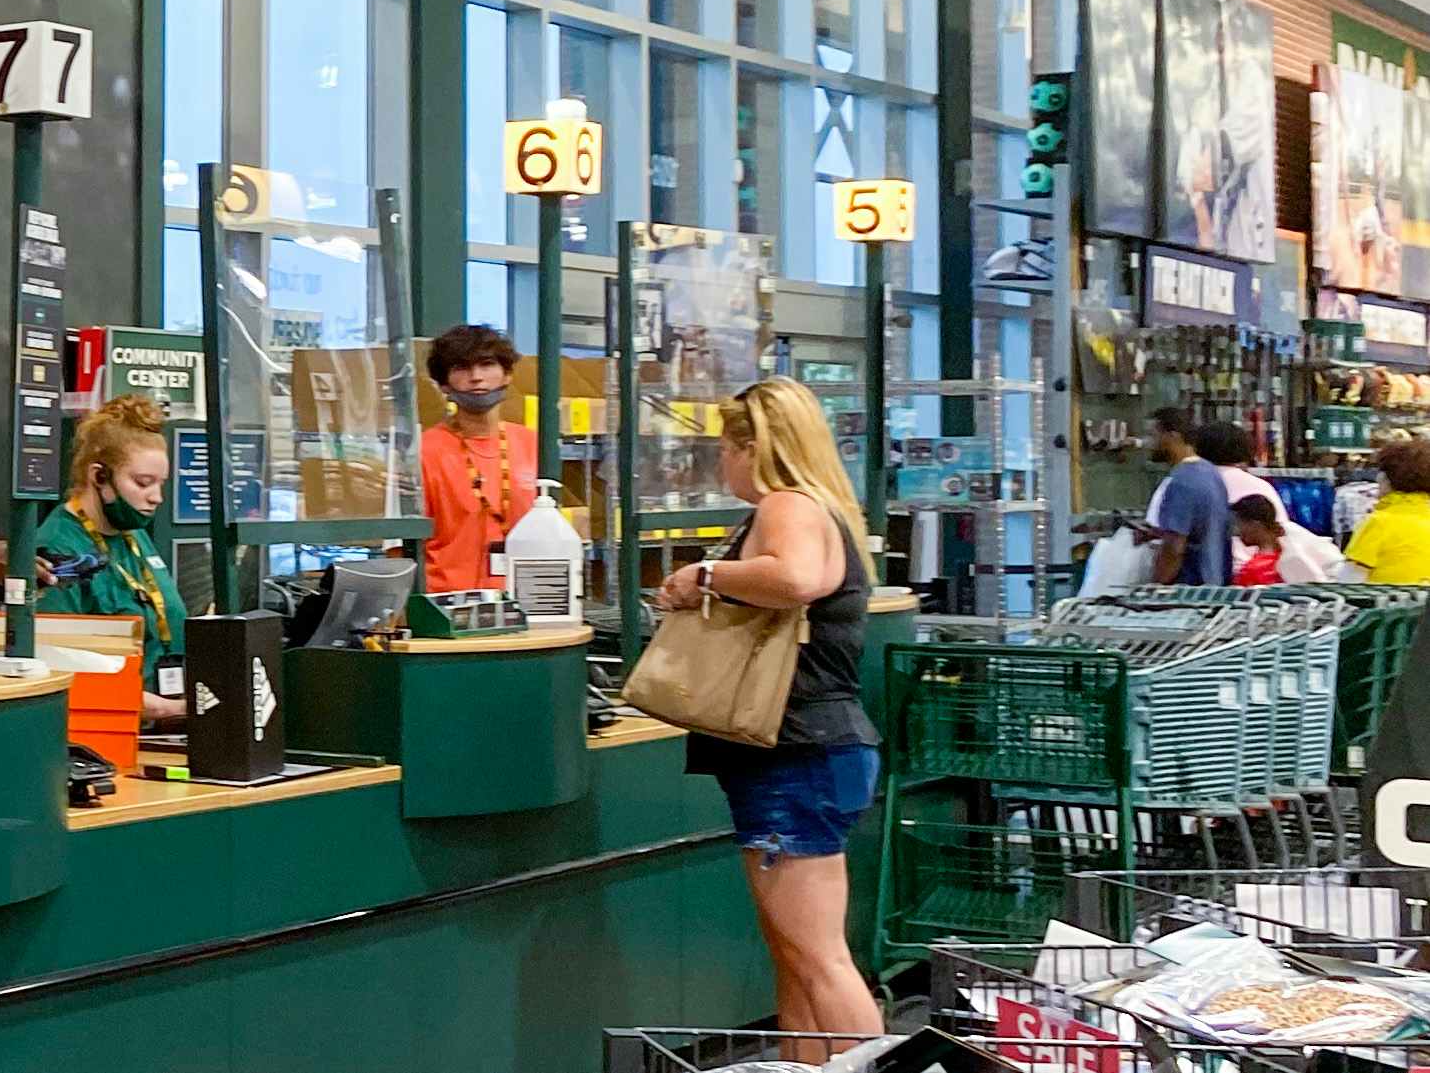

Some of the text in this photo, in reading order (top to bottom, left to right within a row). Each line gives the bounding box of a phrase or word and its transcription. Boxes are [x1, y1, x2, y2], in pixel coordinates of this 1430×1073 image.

[52, 29, 81, 103] 7
[517, 127, 557, 186] 6
[576, 127, 594, 185] 6
[845, 188, 880, 234] 5
[127, 369, 189, 389] CENTER
[1016, 1012, 1098, 1073] SALE
